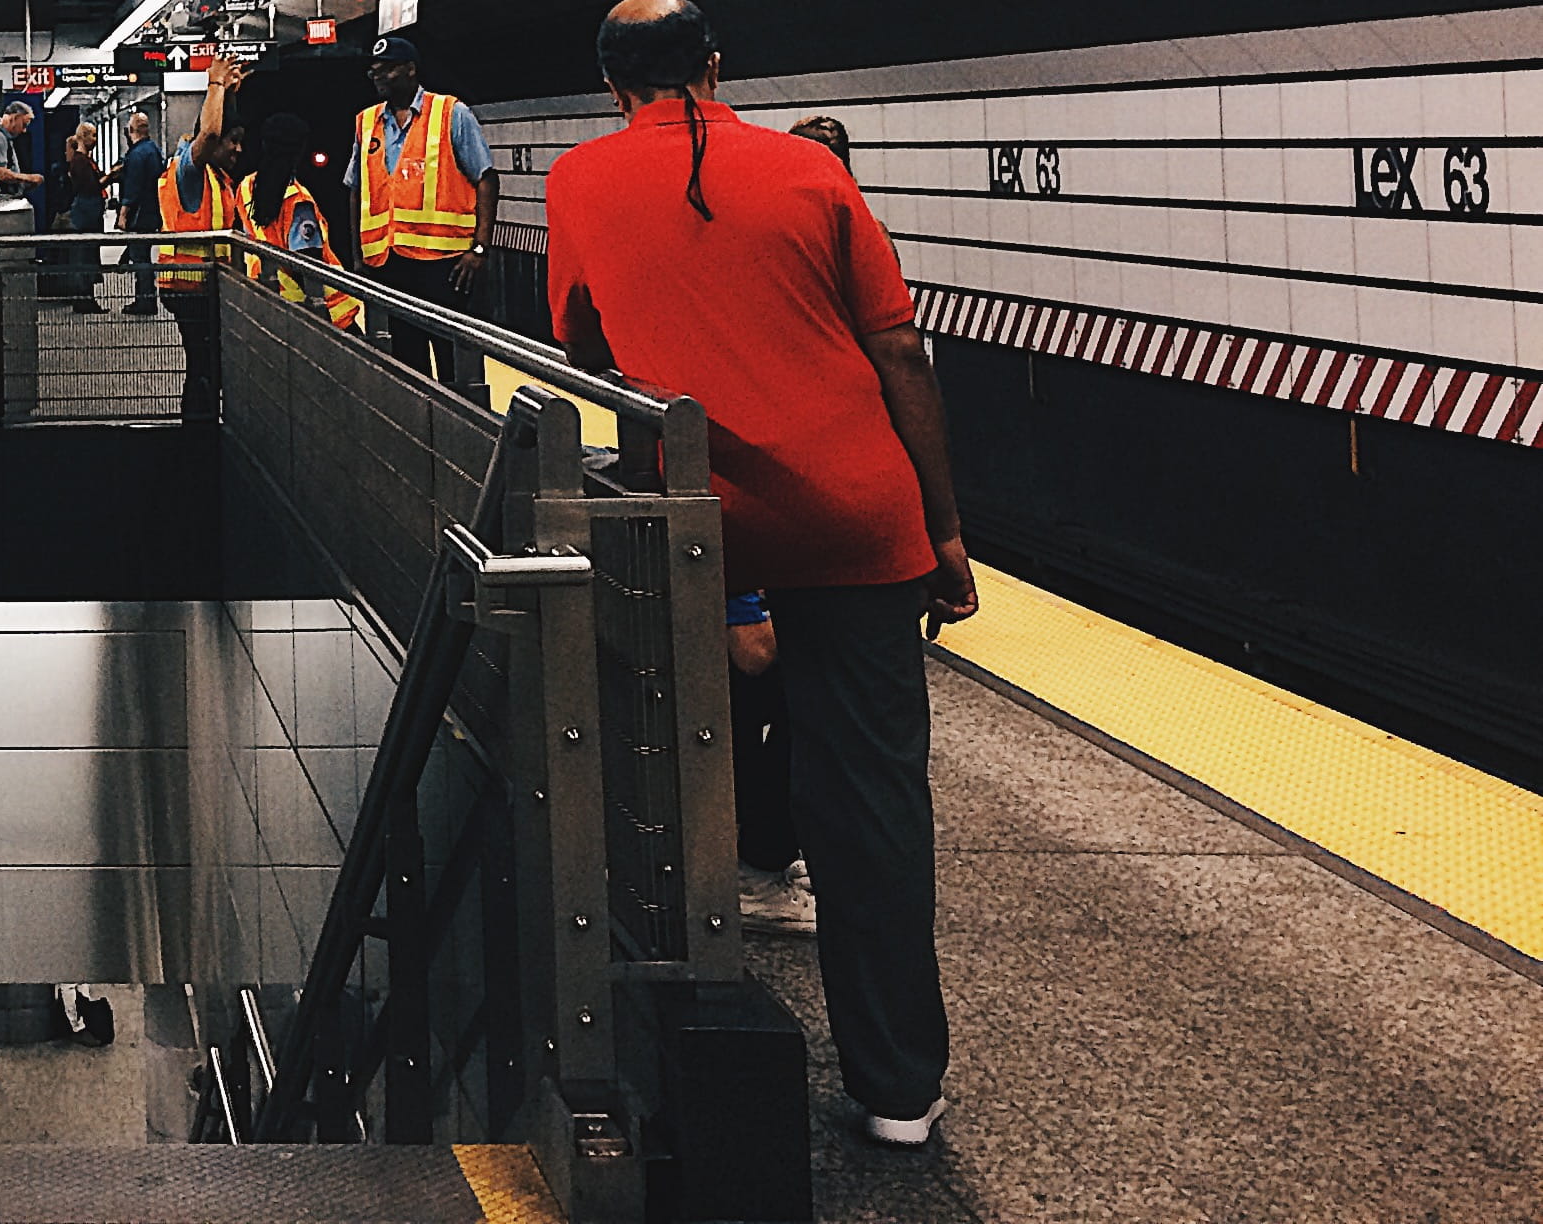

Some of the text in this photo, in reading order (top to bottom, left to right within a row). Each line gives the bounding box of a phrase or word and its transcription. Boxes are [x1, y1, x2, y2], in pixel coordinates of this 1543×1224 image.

[189, 44, 215, 56] Exit
[13, 67, 50, 85] Exit
[987, 145, 1061, 195] Lex 63
[1353, 146, 1490, 214] Lex 63
